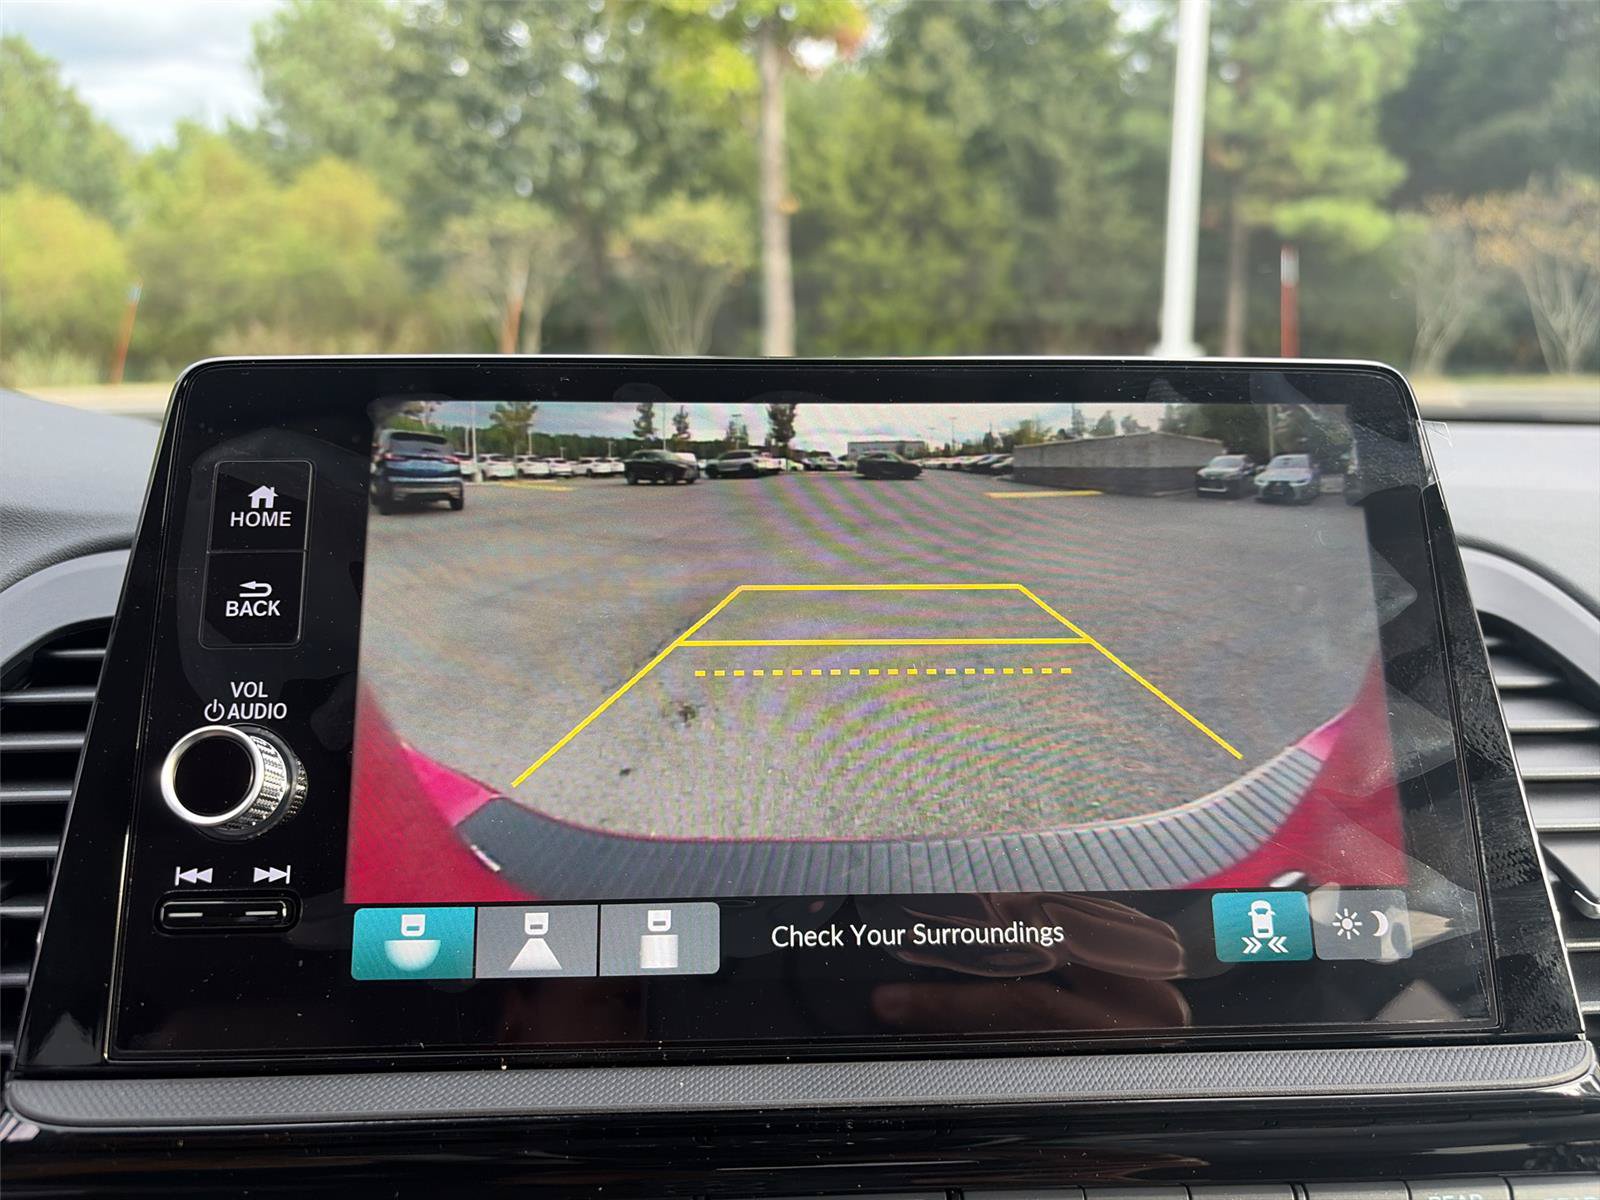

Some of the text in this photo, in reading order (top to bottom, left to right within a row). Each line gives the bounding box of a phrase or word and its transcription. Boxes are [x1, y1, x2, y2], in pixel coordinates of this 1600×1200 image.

[230, 511, 292, 527] HOME
[225, 600, 281, 617] BACK
[230, 681, 268, 698] VOL
[227, 702, 288, 720] AUDIO
[771, 921, 1065, 947] Check Your Surroundings
